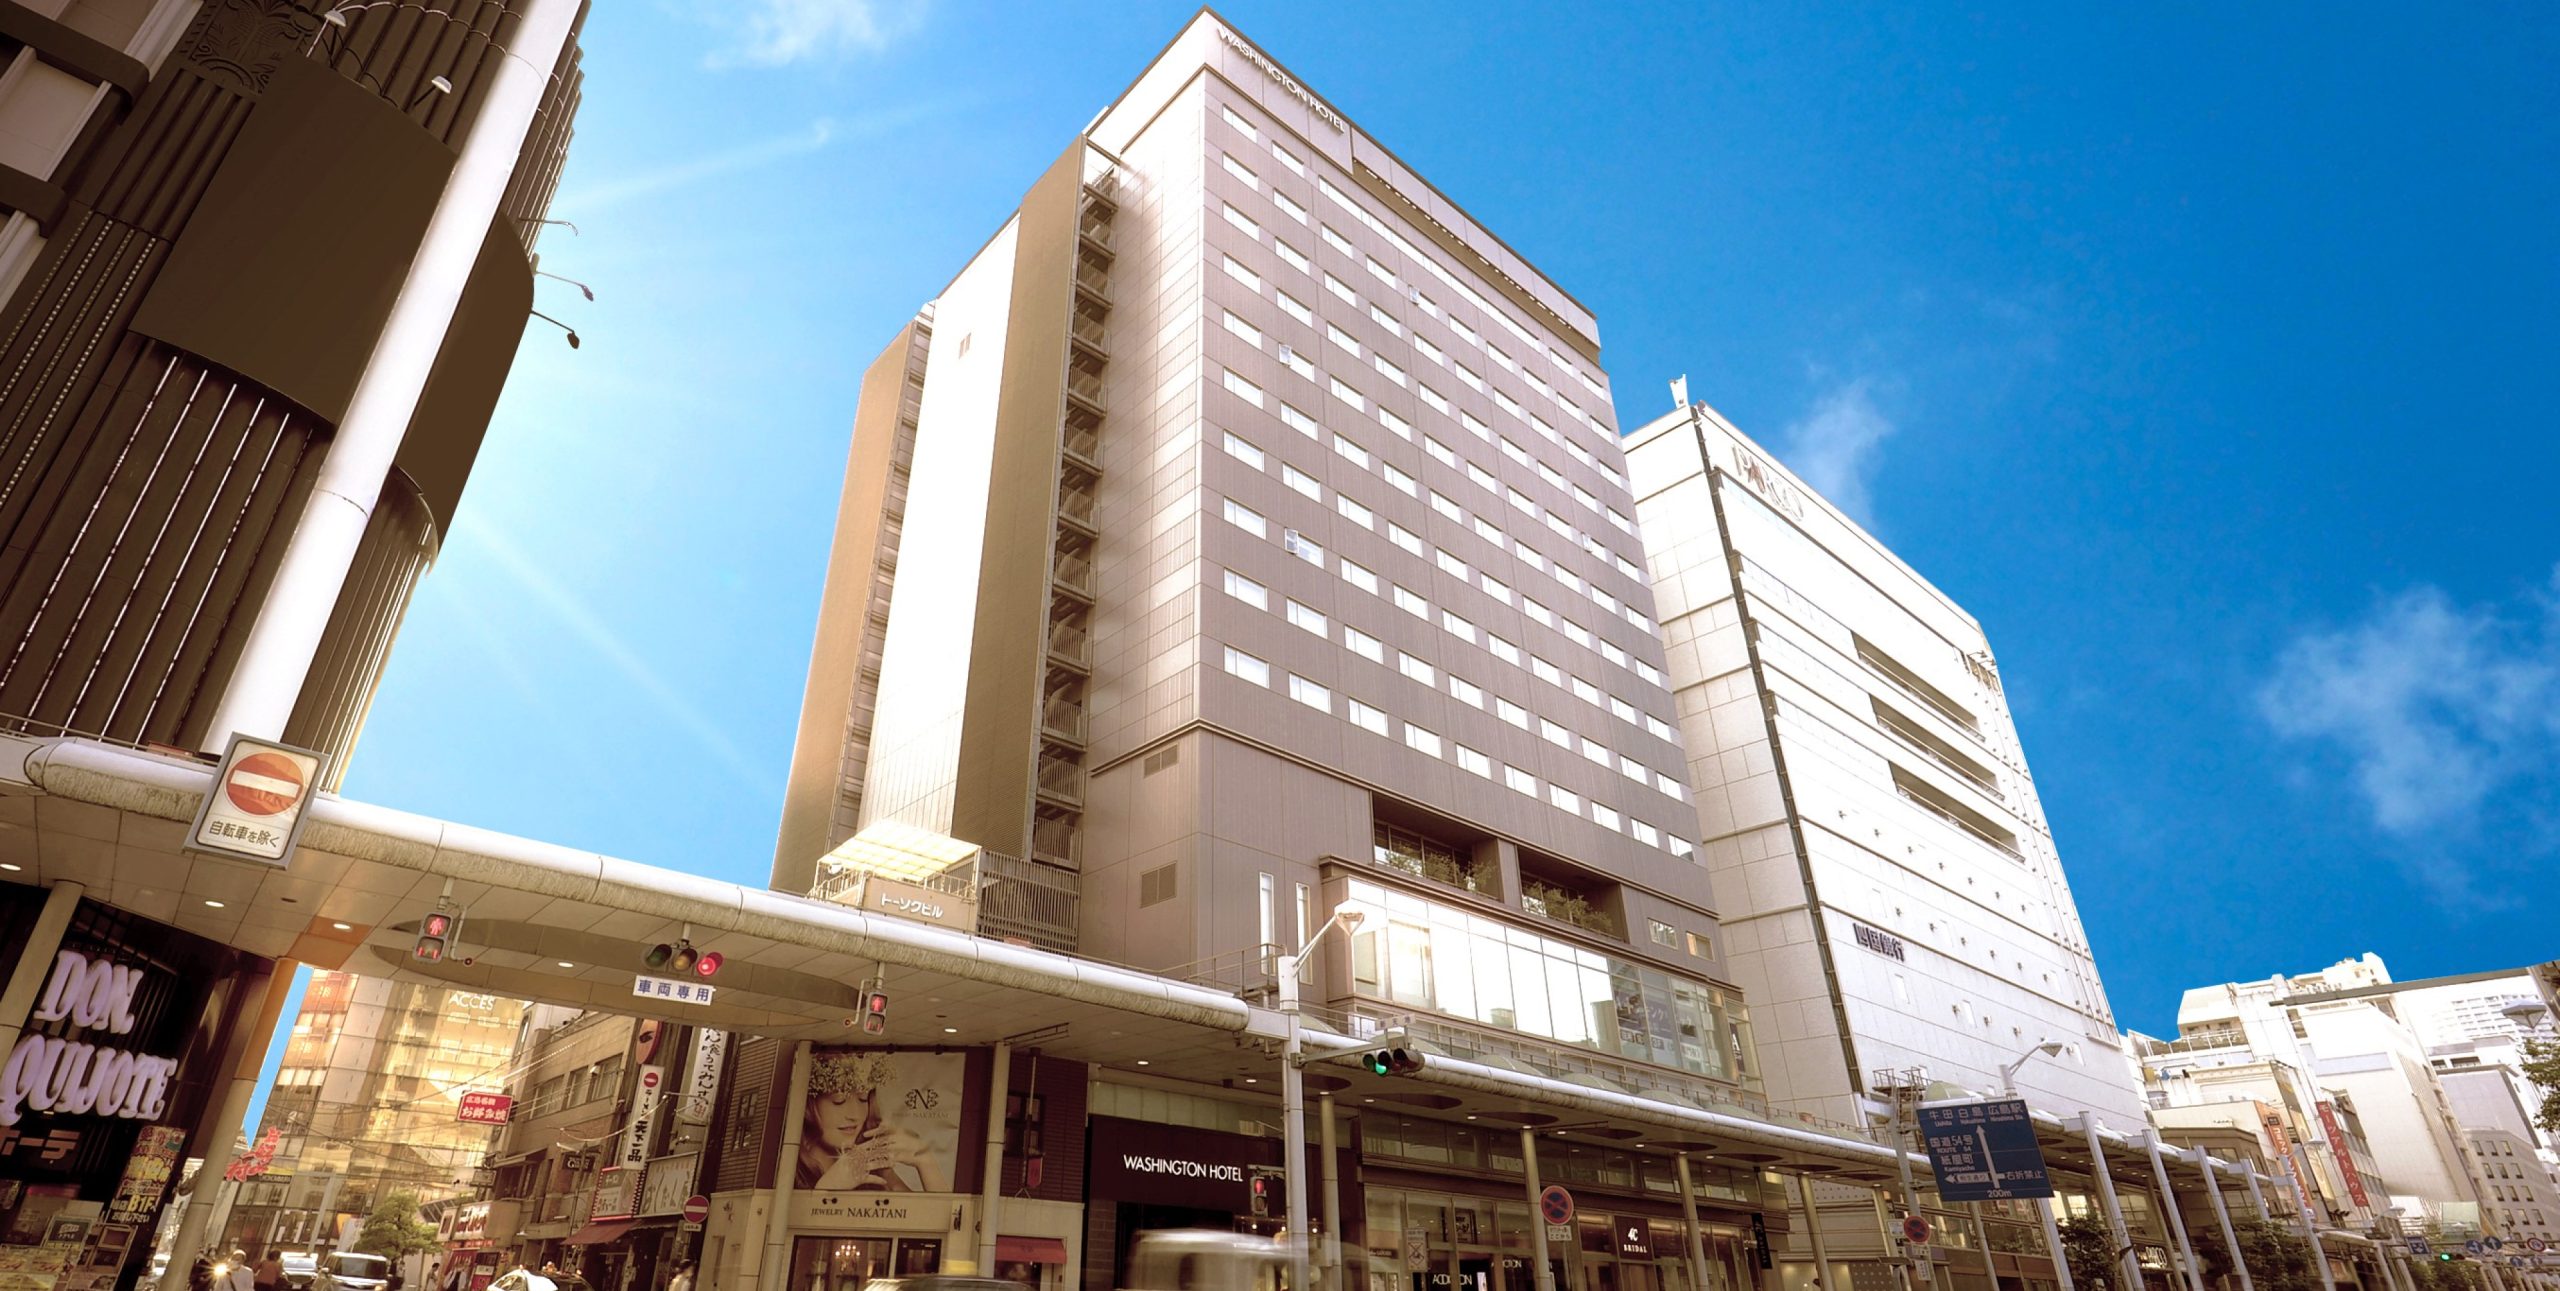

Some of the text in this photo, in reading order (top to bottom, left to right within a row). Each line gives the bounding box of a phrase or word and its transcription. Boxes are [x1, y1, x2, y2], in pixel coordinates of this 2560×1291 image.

[1217, 25, 1344, 134] WASHINGTON HOTEL
[209, 820, 280, 848] 自転車を除く
[881, 892, 944, 918] トーソクビル
[1852, 922, 1904, 963] 四国銀行
[33, 950, 144, 1034] DON
[637, 979, 710, 1002] 車両専用
[0, 1034, 178, 1126] QUIJOTE
[627, 1120, 648, 1163] 天下一品
[1123, 1154, 1243, 1182] WASHINGTON HOTEL
[1986, 1189, 2013, 1198] 200m
[811, 1207, 908, 1219] JEWELRY NAKATANI
[1623, 1244, 1648, 1254] BRIDAL
